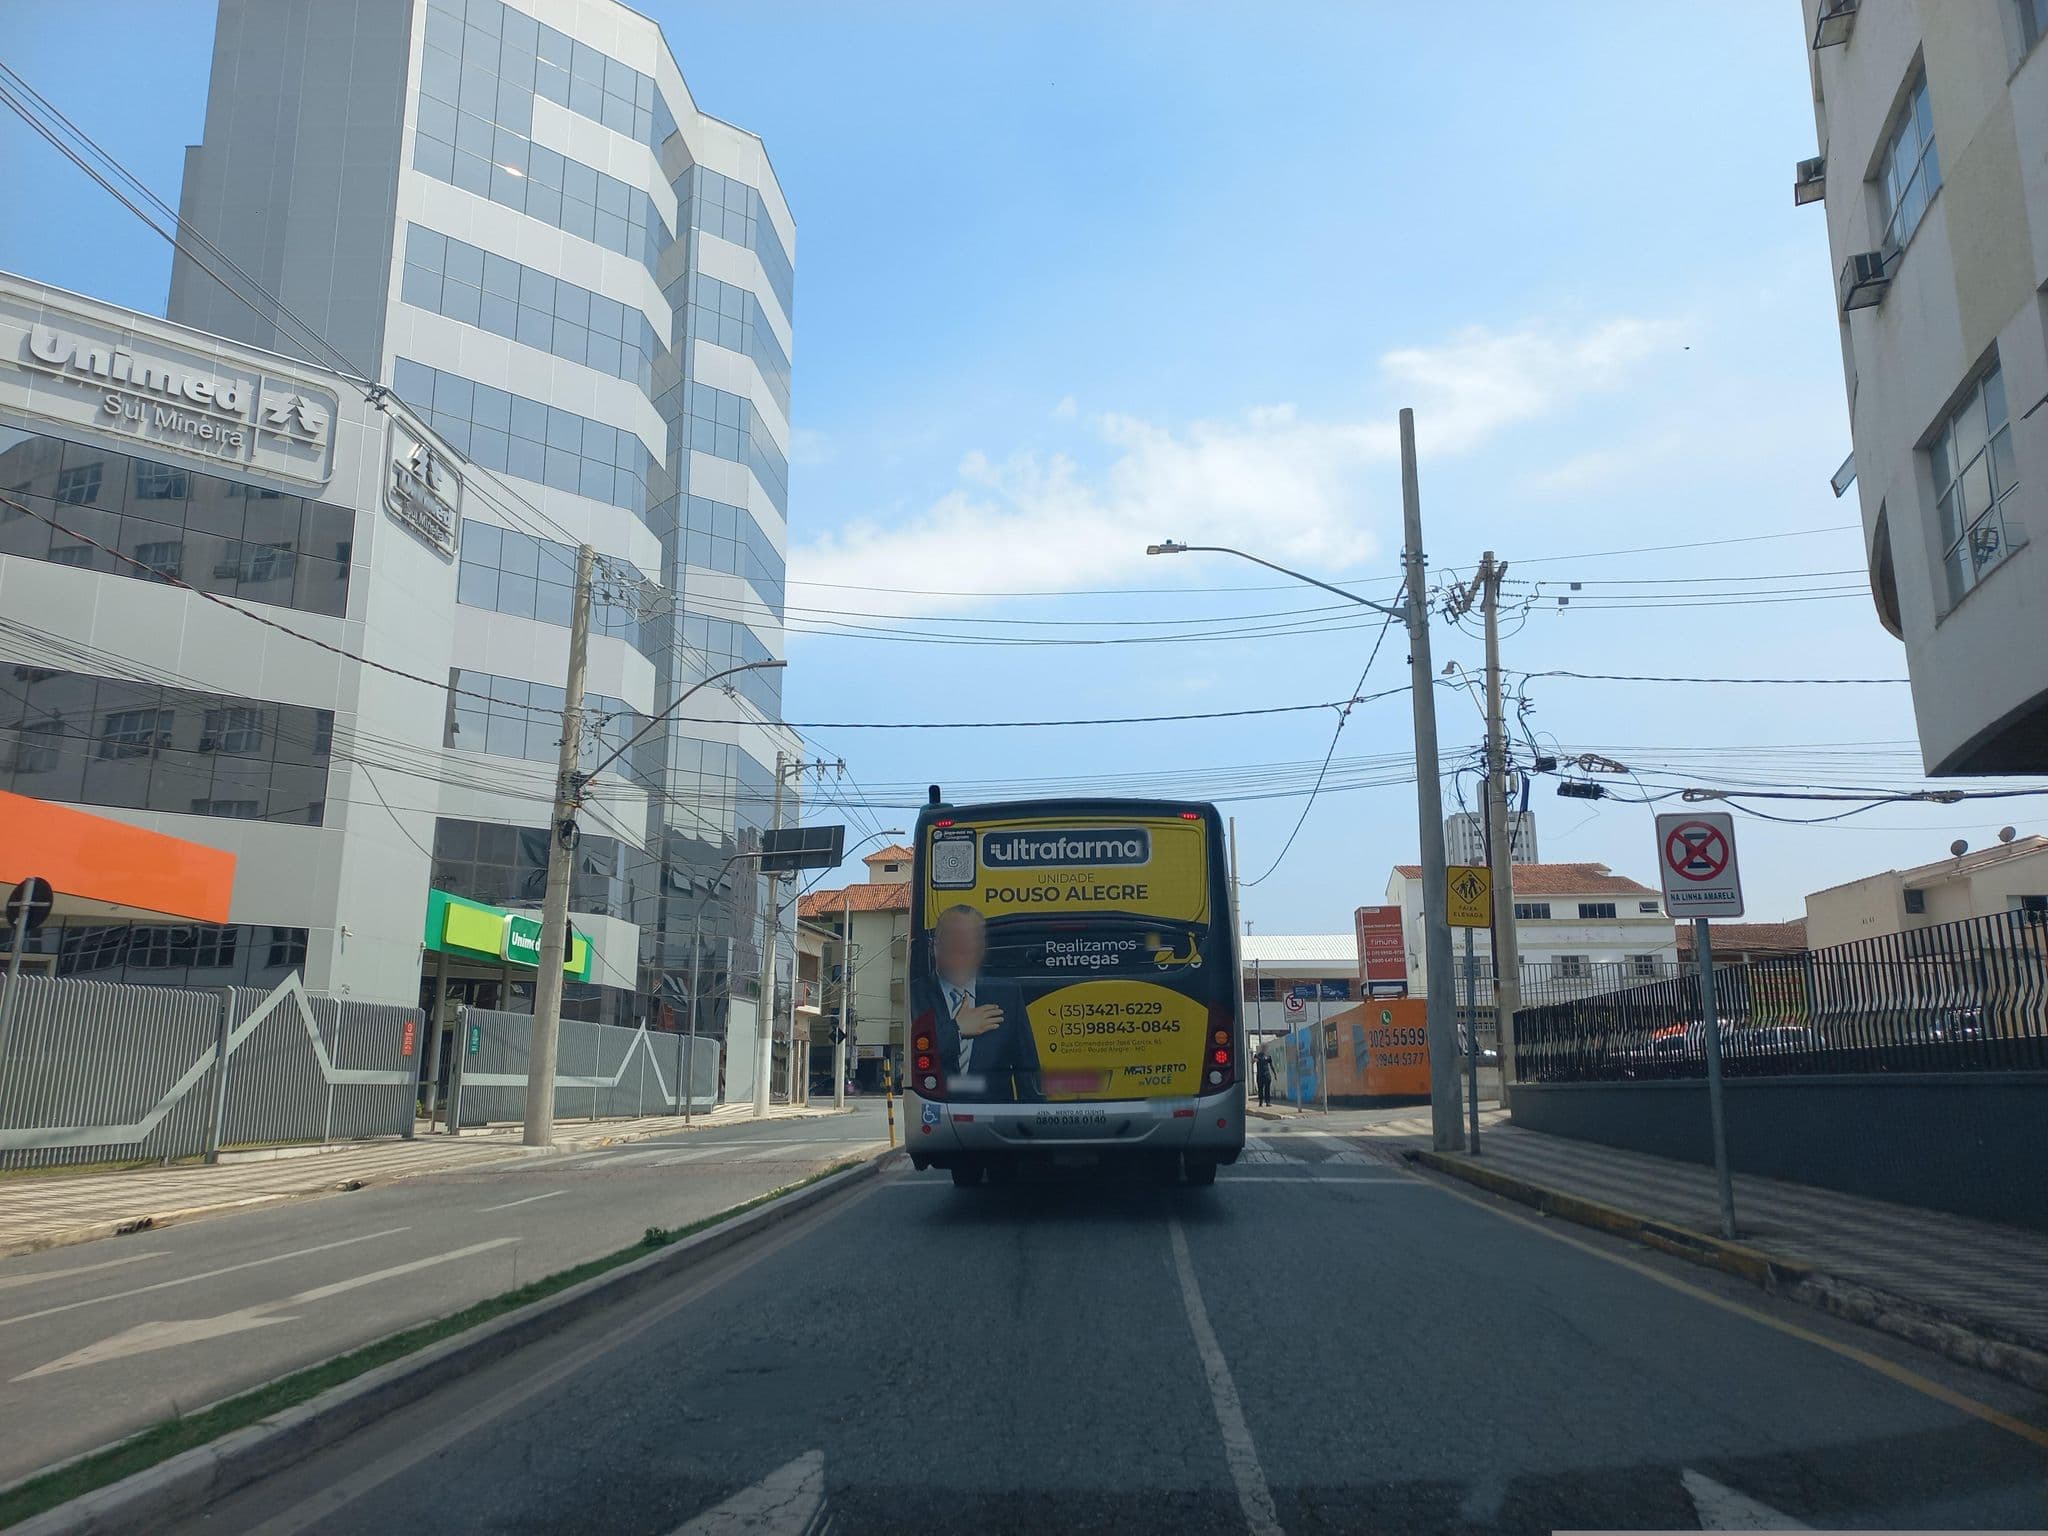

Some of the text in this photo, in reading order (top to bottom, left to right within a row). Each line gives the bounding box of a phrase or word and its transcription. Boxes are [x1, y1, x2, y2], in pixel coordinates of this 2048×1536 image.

[30, 323, 250, 413] Unimed
[104, 393, 244, 447] Sul Mineira
[992, 837, 1141, 861] ultrafarma
[1037, 872, 1096, 884] UNIDADE
[985, 884, 1149, 903] POUSO ALEGRE
[1670, 892, 1735, 901] NA LINHA AMARELA
[1045, 939, 1137, 953] Realizamos
[1045, 954, 1120, 969] entregas
[1123, 1063, 1187, 1076] MAIS PERTO
